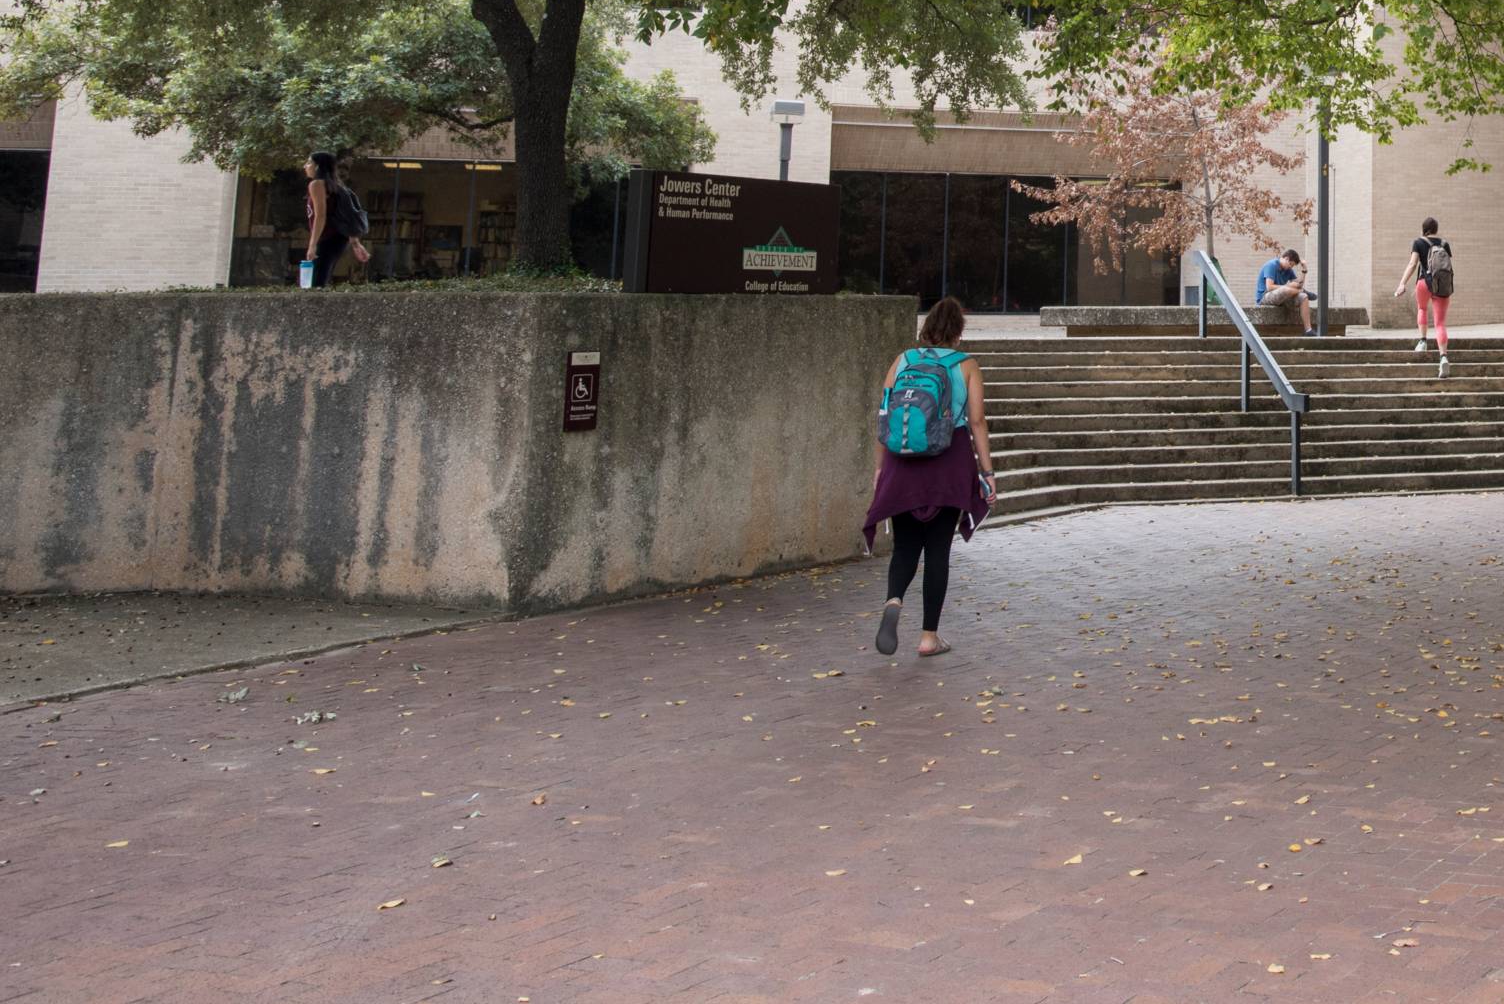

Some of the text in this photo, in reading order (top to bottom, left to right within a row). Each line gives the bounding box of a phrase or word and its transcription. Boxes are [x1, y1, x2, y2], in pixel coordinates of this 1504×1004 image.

[660, 176, 741, 197] Jowers Center
[659, 193, 732, 208] Department of Health
[659, 206, 734, 221] & Human Performance
[745, 253, 815, 268] ACHIEVEMENT
[745, 281, 809, 292] College of Education
